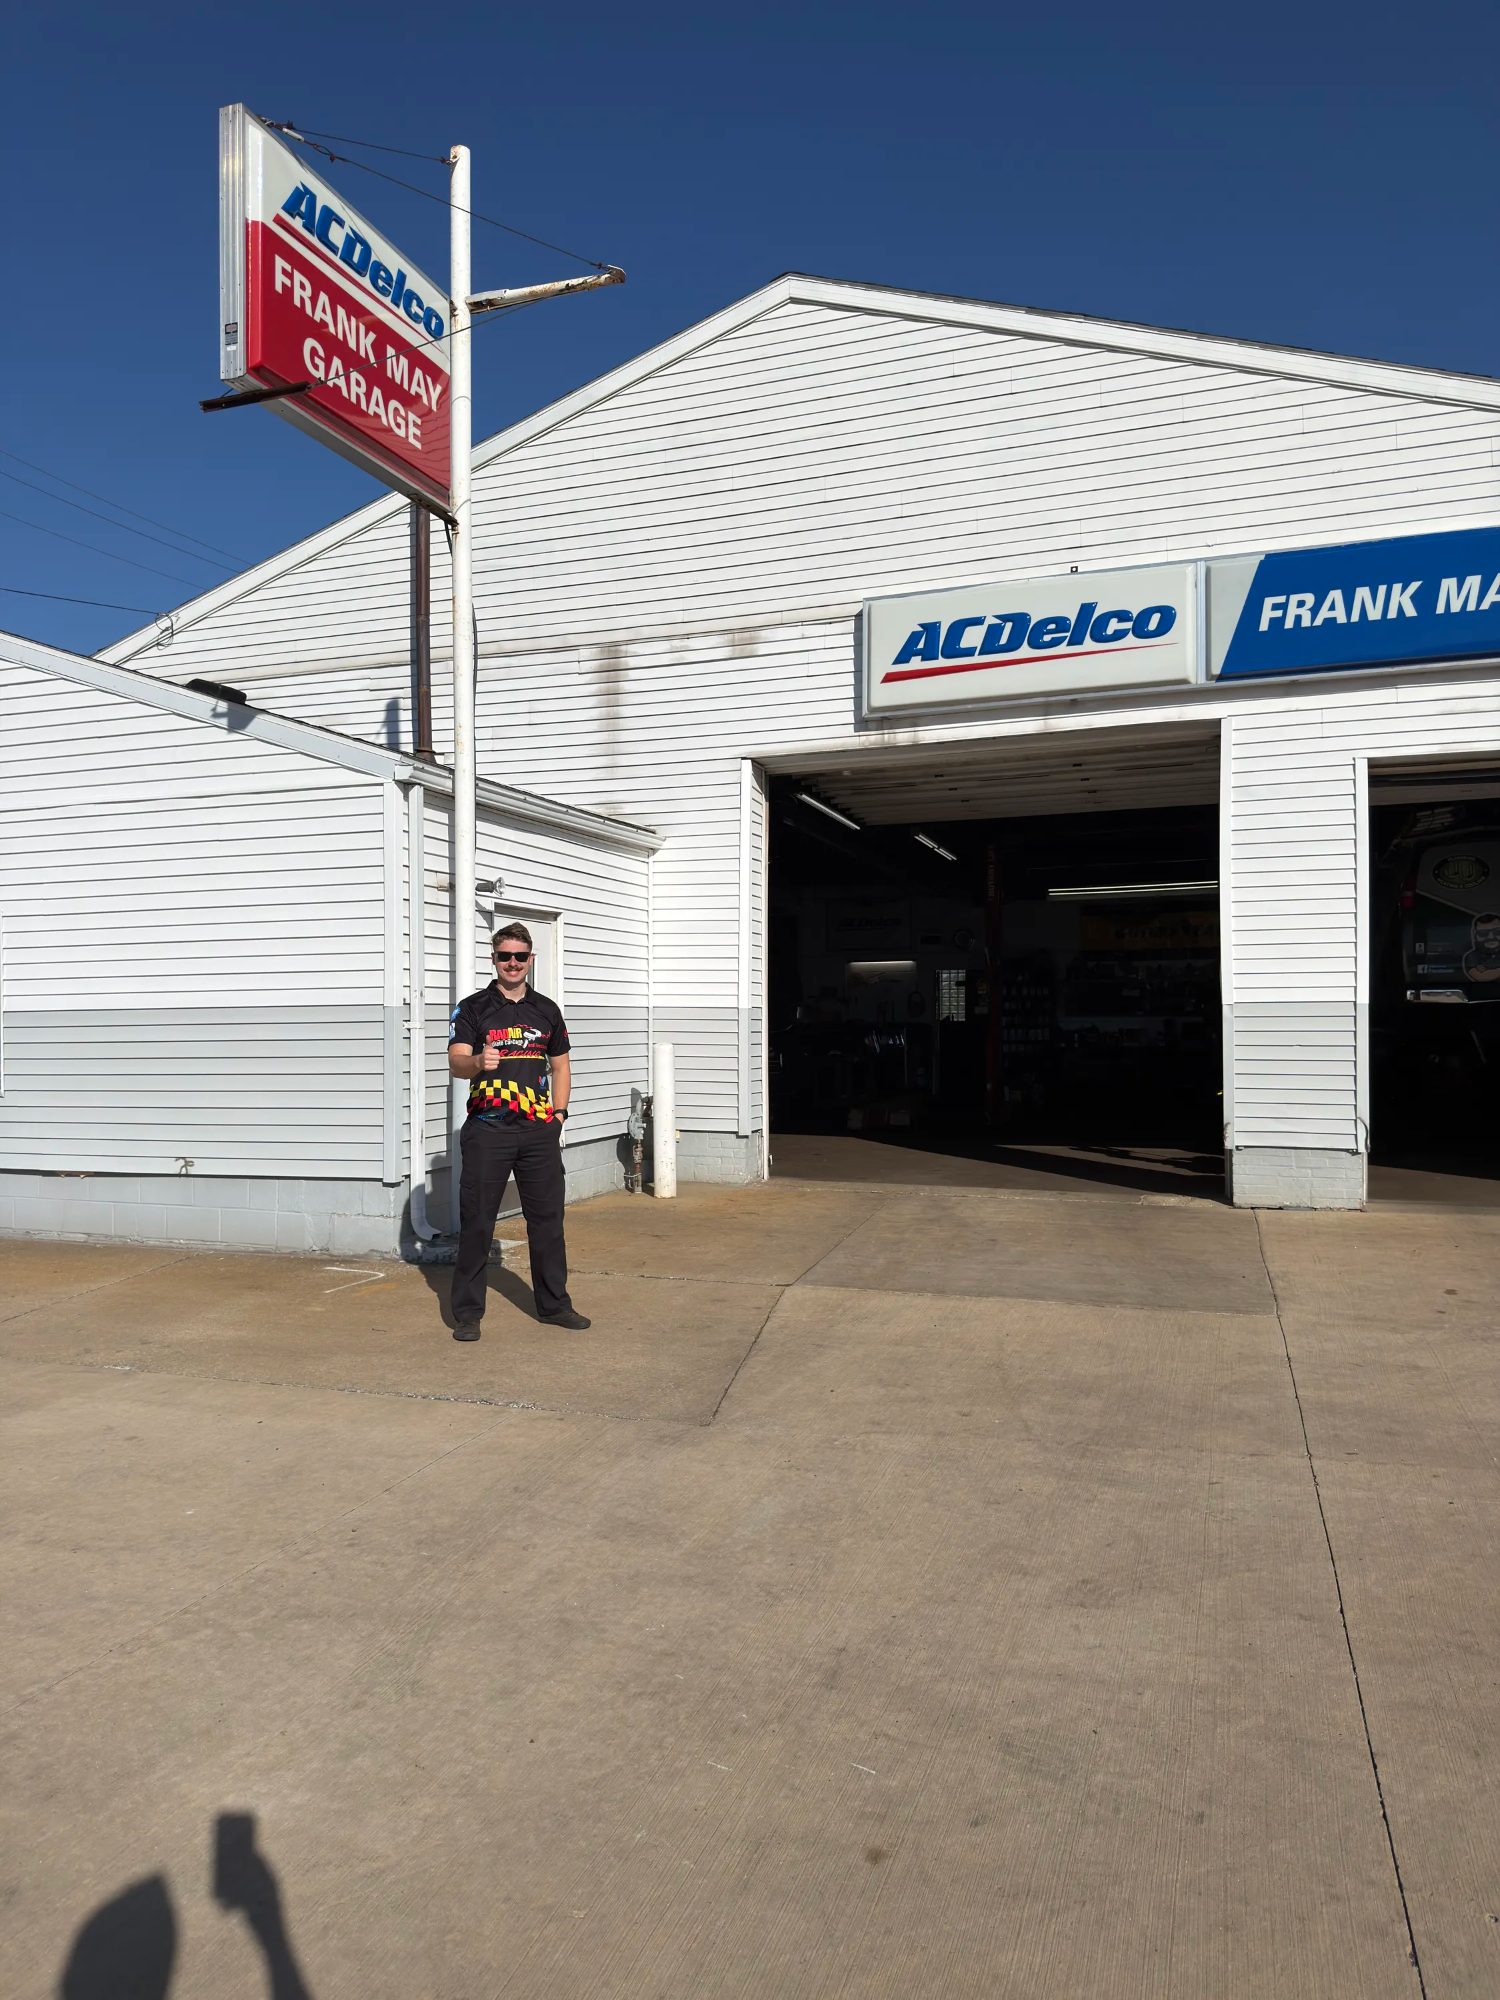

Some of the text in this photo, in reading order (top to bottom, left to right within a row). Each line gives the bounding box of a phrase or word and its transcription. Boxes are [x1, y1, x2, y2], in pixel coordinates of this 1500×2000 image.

[281, 181, 445, 341] ACDelco
[275, 254, 442, 413] FRANK MAY
[303, 337, 422, 450] GARAGE
[891, 601, 1177, 665] ACDelco
[1258, 580, 1423, 632] FRANK
